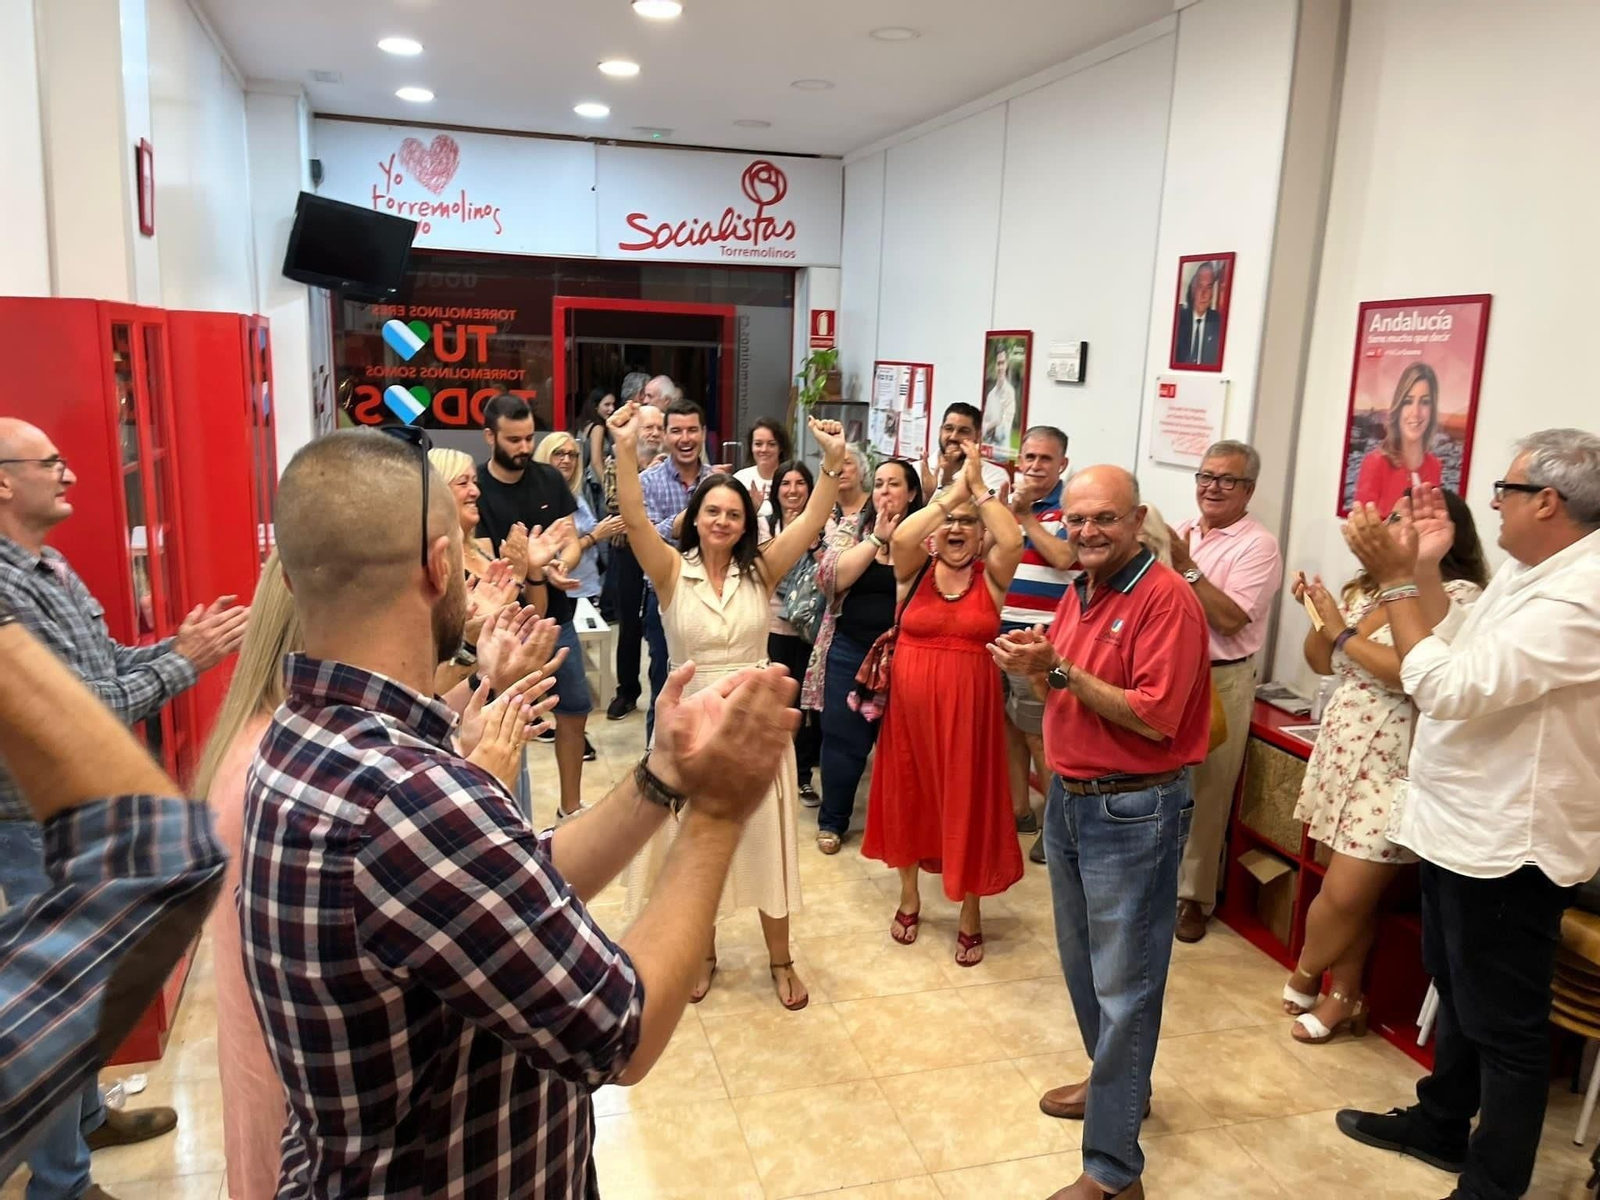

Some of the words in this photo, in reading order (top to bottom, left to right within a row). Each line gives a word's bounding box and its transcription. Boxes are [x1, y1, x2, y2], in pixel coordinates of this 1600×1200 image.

[378, 153, 403, 194] Yo
[372, 184, 502, 235] torremolinos
[618, 203, 796, 251] Socialistas
[720, 245, 797, 259] Torremolinos
[1368, 309, 1453, 332] Andalucía
